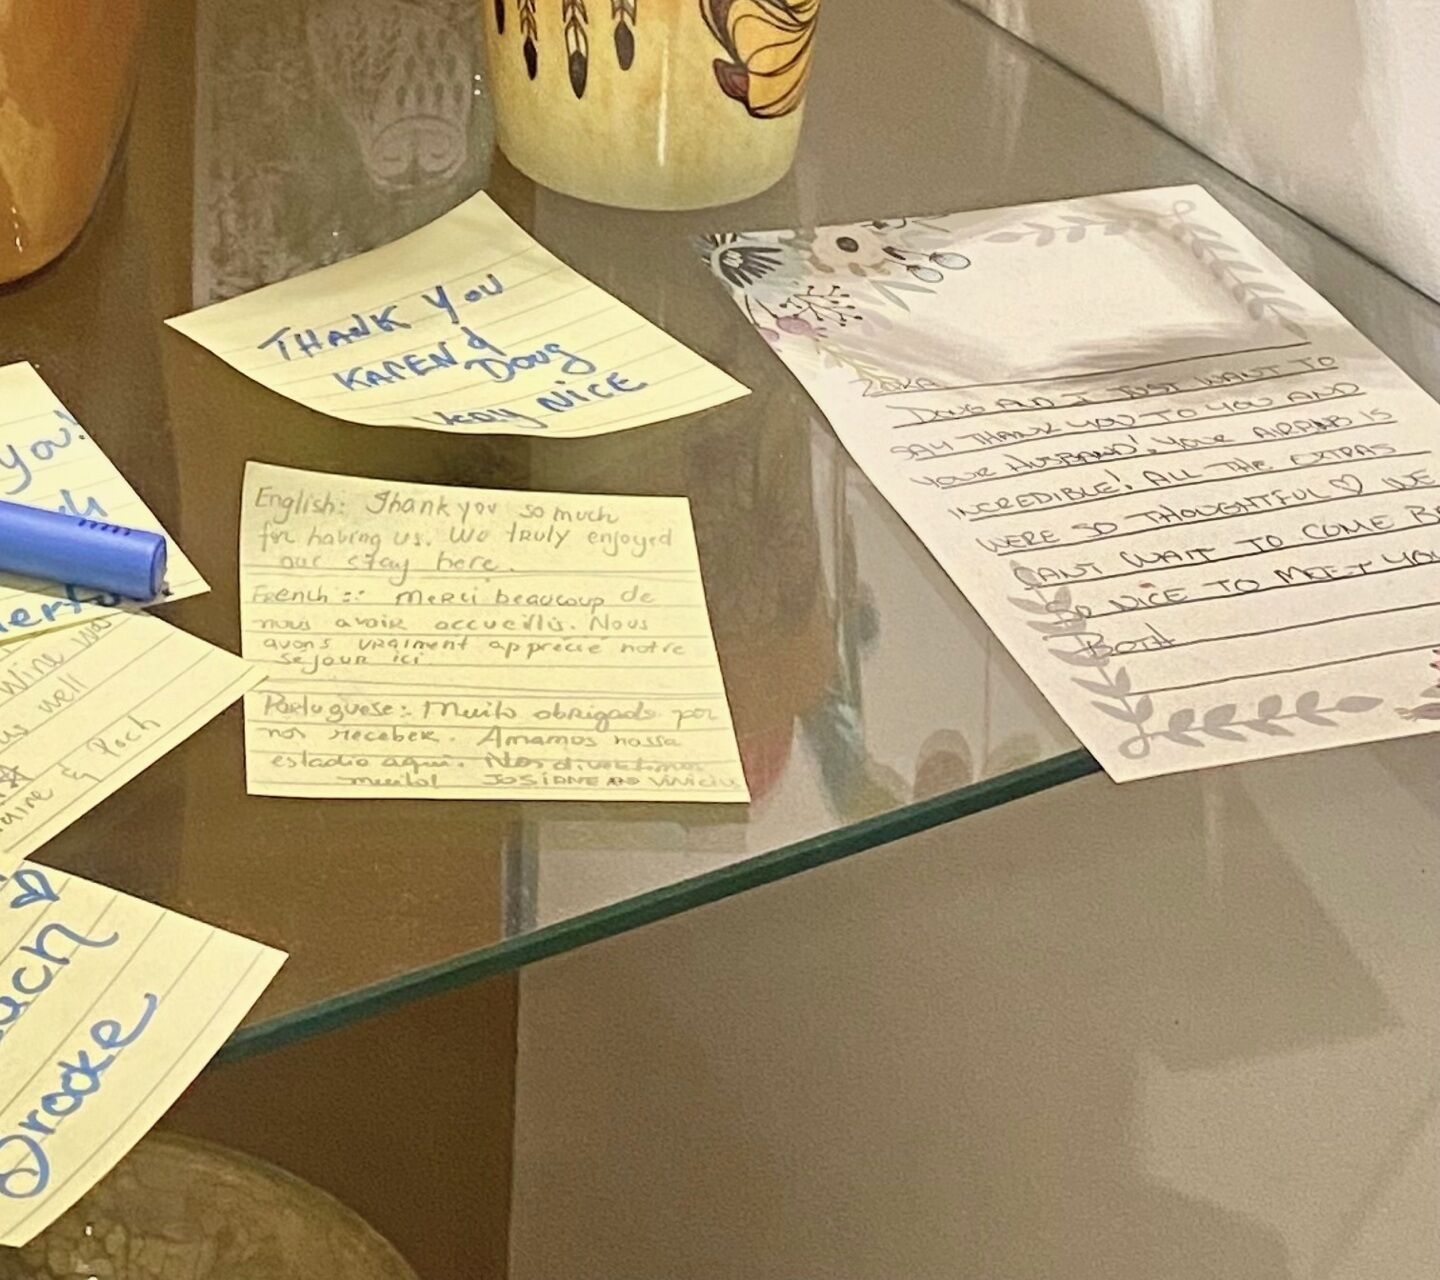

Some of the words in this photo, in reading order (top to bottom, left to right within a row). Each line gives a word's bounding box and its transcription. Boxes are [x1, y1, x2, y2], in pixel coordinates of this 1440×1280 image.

[1062, 391, 1091, 403] I
[1287, 355, 1337, 370] TO
[1138, 407, 1199, 423] TO
[1359, 407, 1393, 421] IS
[1142, 468, 1203, 487] ALL
[254, 486, 346, 525] English:
[364, 489, 450, 518] Thank
[457, 498, 498, 524] you
[519, 503, 546, 520] so
[552, 505, 621, 525] much
[975, 529, 1062, 554] WERE
[1071, 521, 1119, 539] SO
[1123, 488, 1332, 525] THOUGHTFUL
[306, 526, 382, 557] having
[586, 527, 673, 559] enjoyed
[1119, 547, 1216, 569] WAIT
[1233, 534, 1285, 554] TO
[1301, 514, 1396, 540] COME
[280, 553, 323, 570] our
[347, 551, 411, 588] stay
[1201, 579, 1261, 593] TO
[494, 588, 605, 615] beaucoup
[620, 585, 656, 604] de
[589, 616, 649, 631] Nous
[263, 637, 331, 651] avons
[619, 640, 687, 655] notre
[392, 650, 425, 666] ici
[37, 673, 88, 716] well
[476, 725, 598, 749] Amamos
[613, 733, 681, 748] nossa
